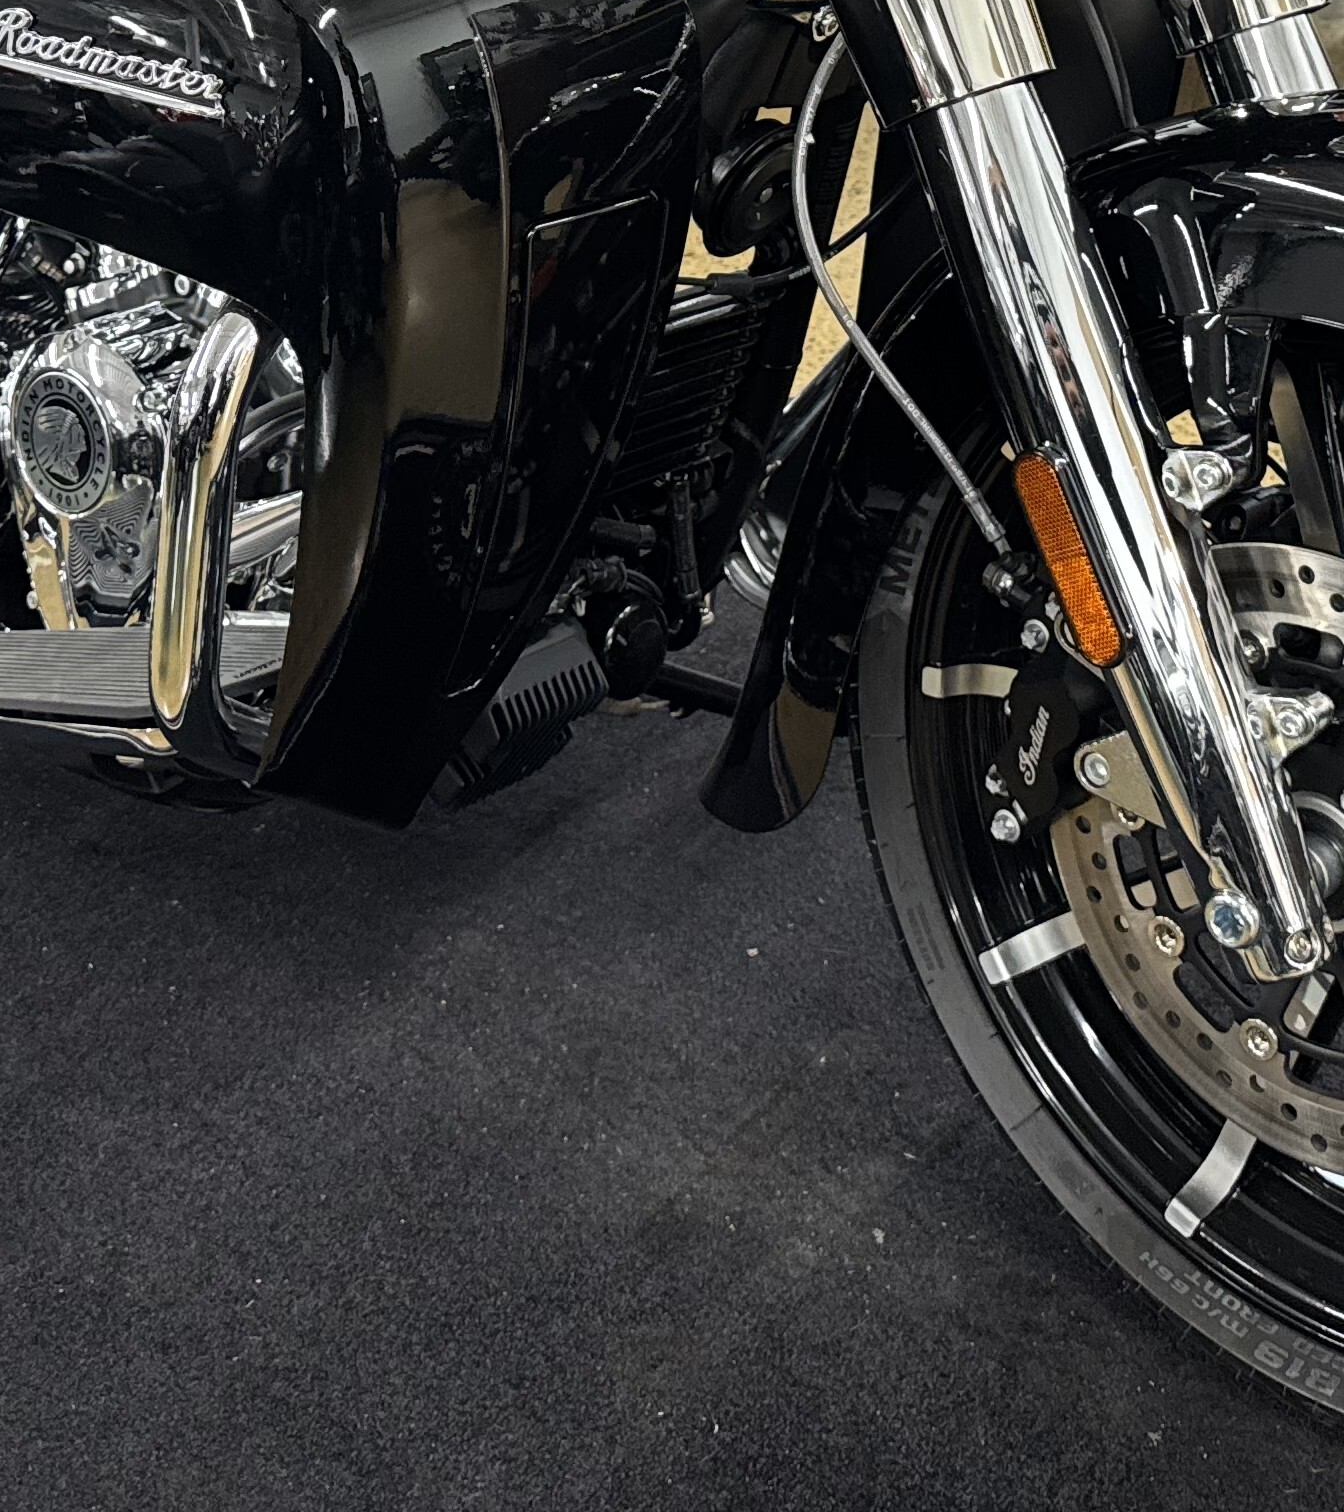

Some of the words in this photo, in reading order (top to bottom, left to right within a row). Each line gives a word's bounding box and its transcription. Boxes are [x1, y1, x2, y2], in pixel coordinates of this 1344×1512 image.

[21, 392, 39, 473] INDIAN
[42, 378, 106, 491] MOTORCYCLE
[1018, 704, 1050, 786] Indian
[1183, 1270, 1280, 1336] FRONT
